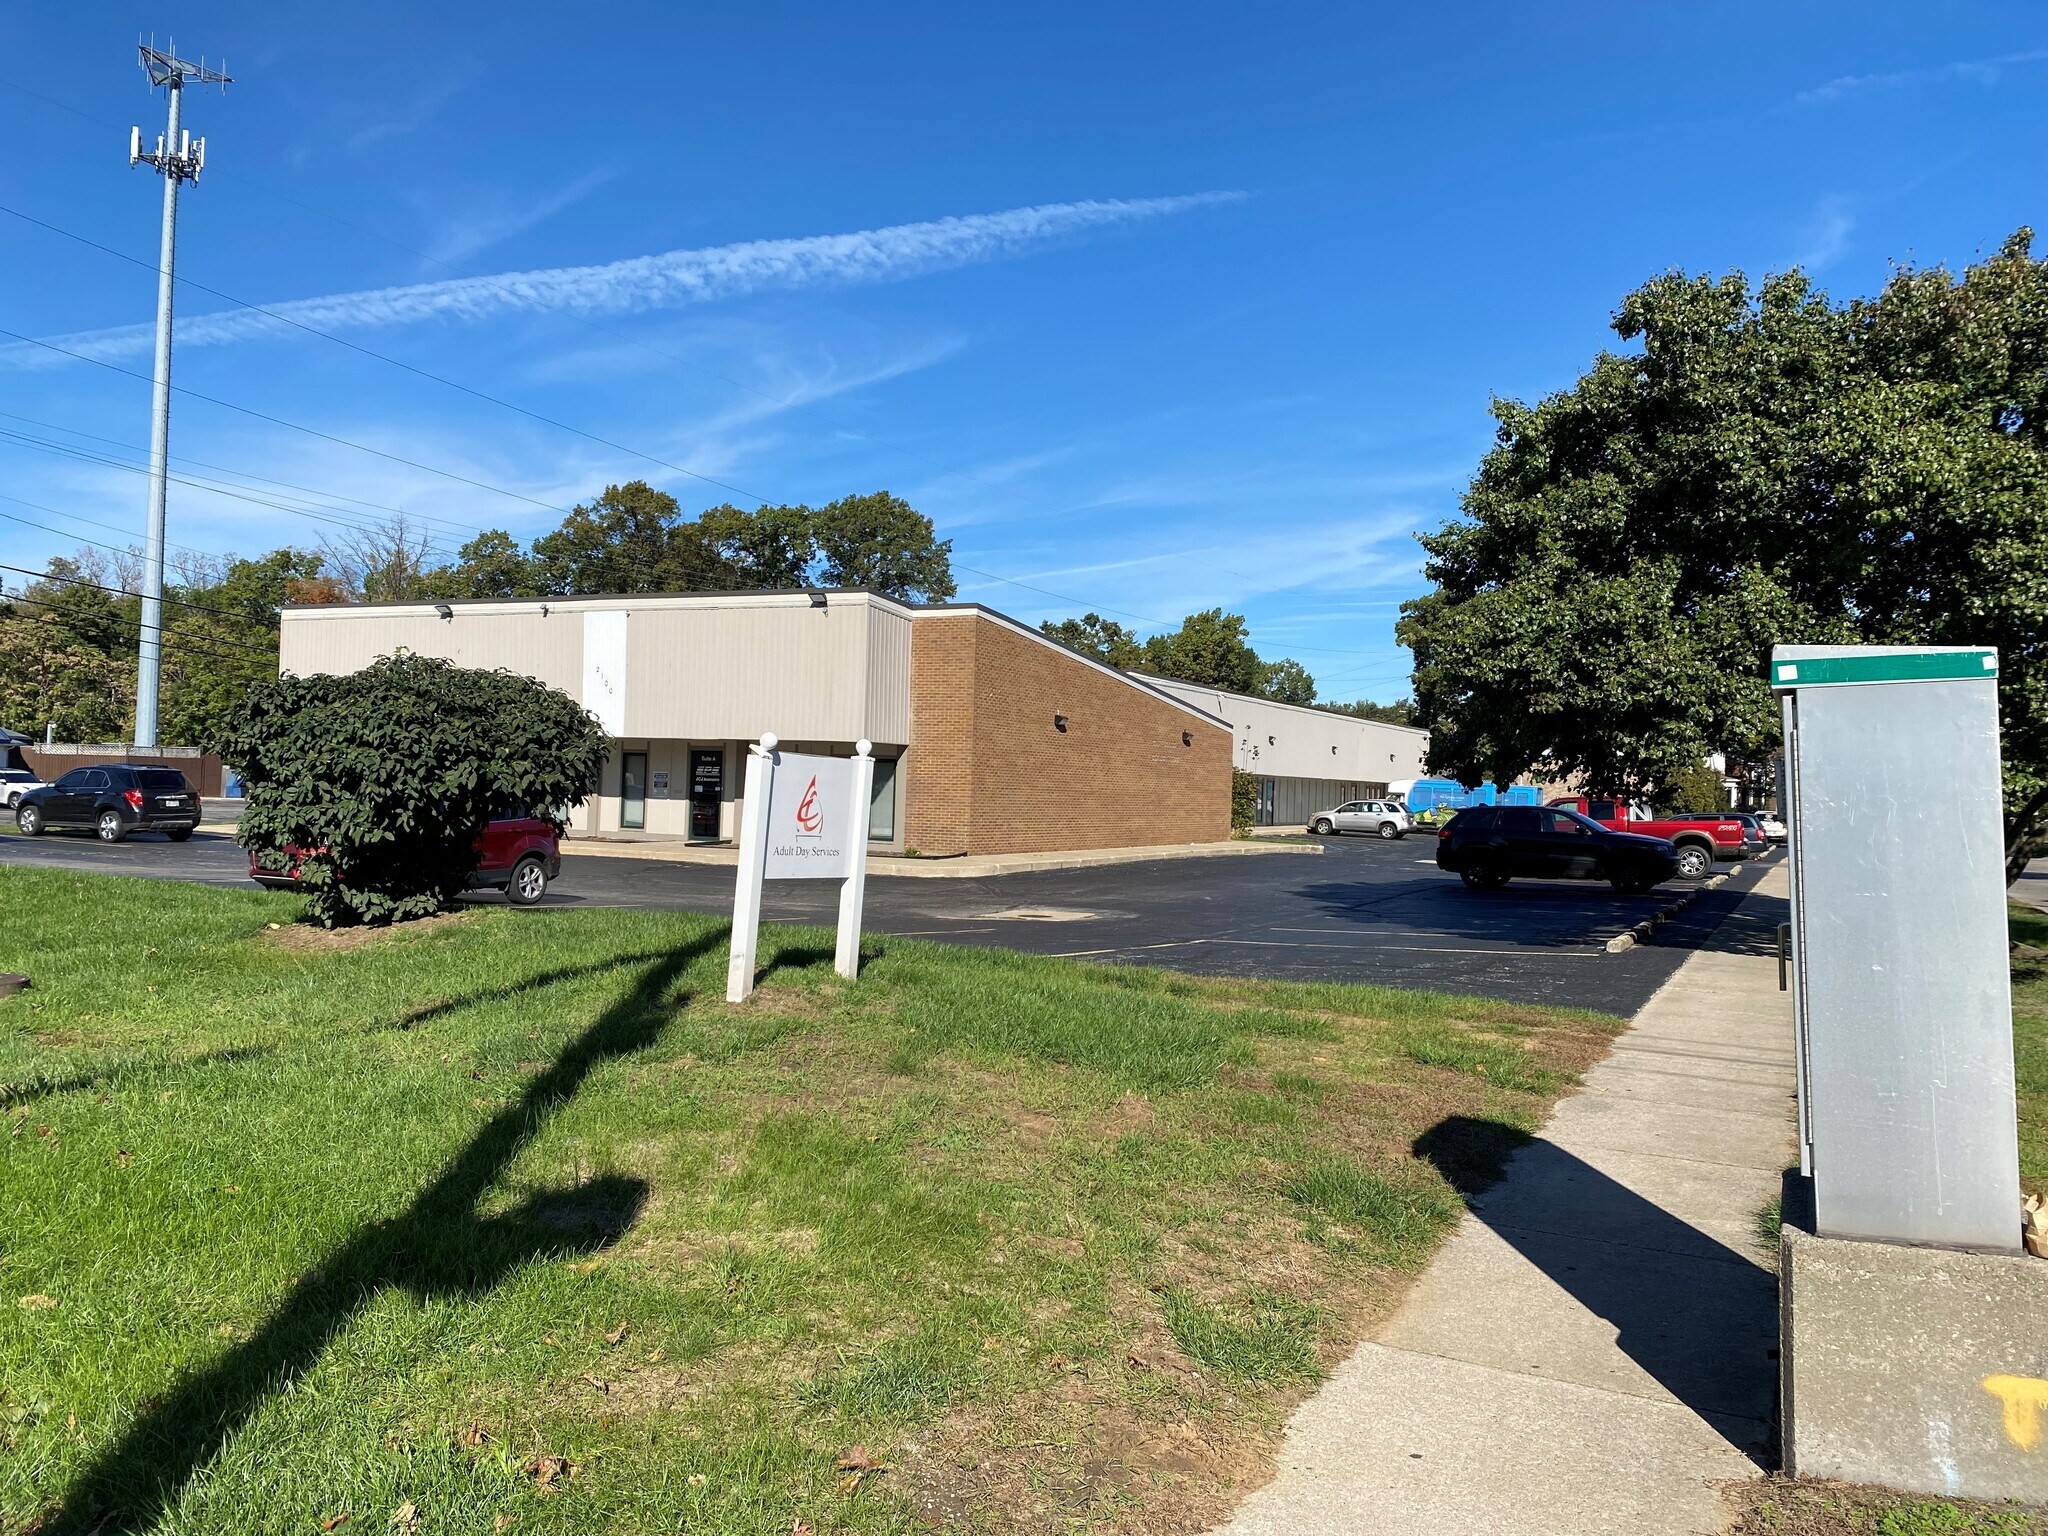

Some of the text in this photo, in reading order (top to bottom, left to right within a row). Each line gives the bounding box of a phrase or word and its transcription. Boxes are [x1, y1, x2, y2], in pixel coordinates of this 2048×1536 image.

[596, 666, 613, 695] 2100
[773, 845, 840, 859] Adult Day Services
